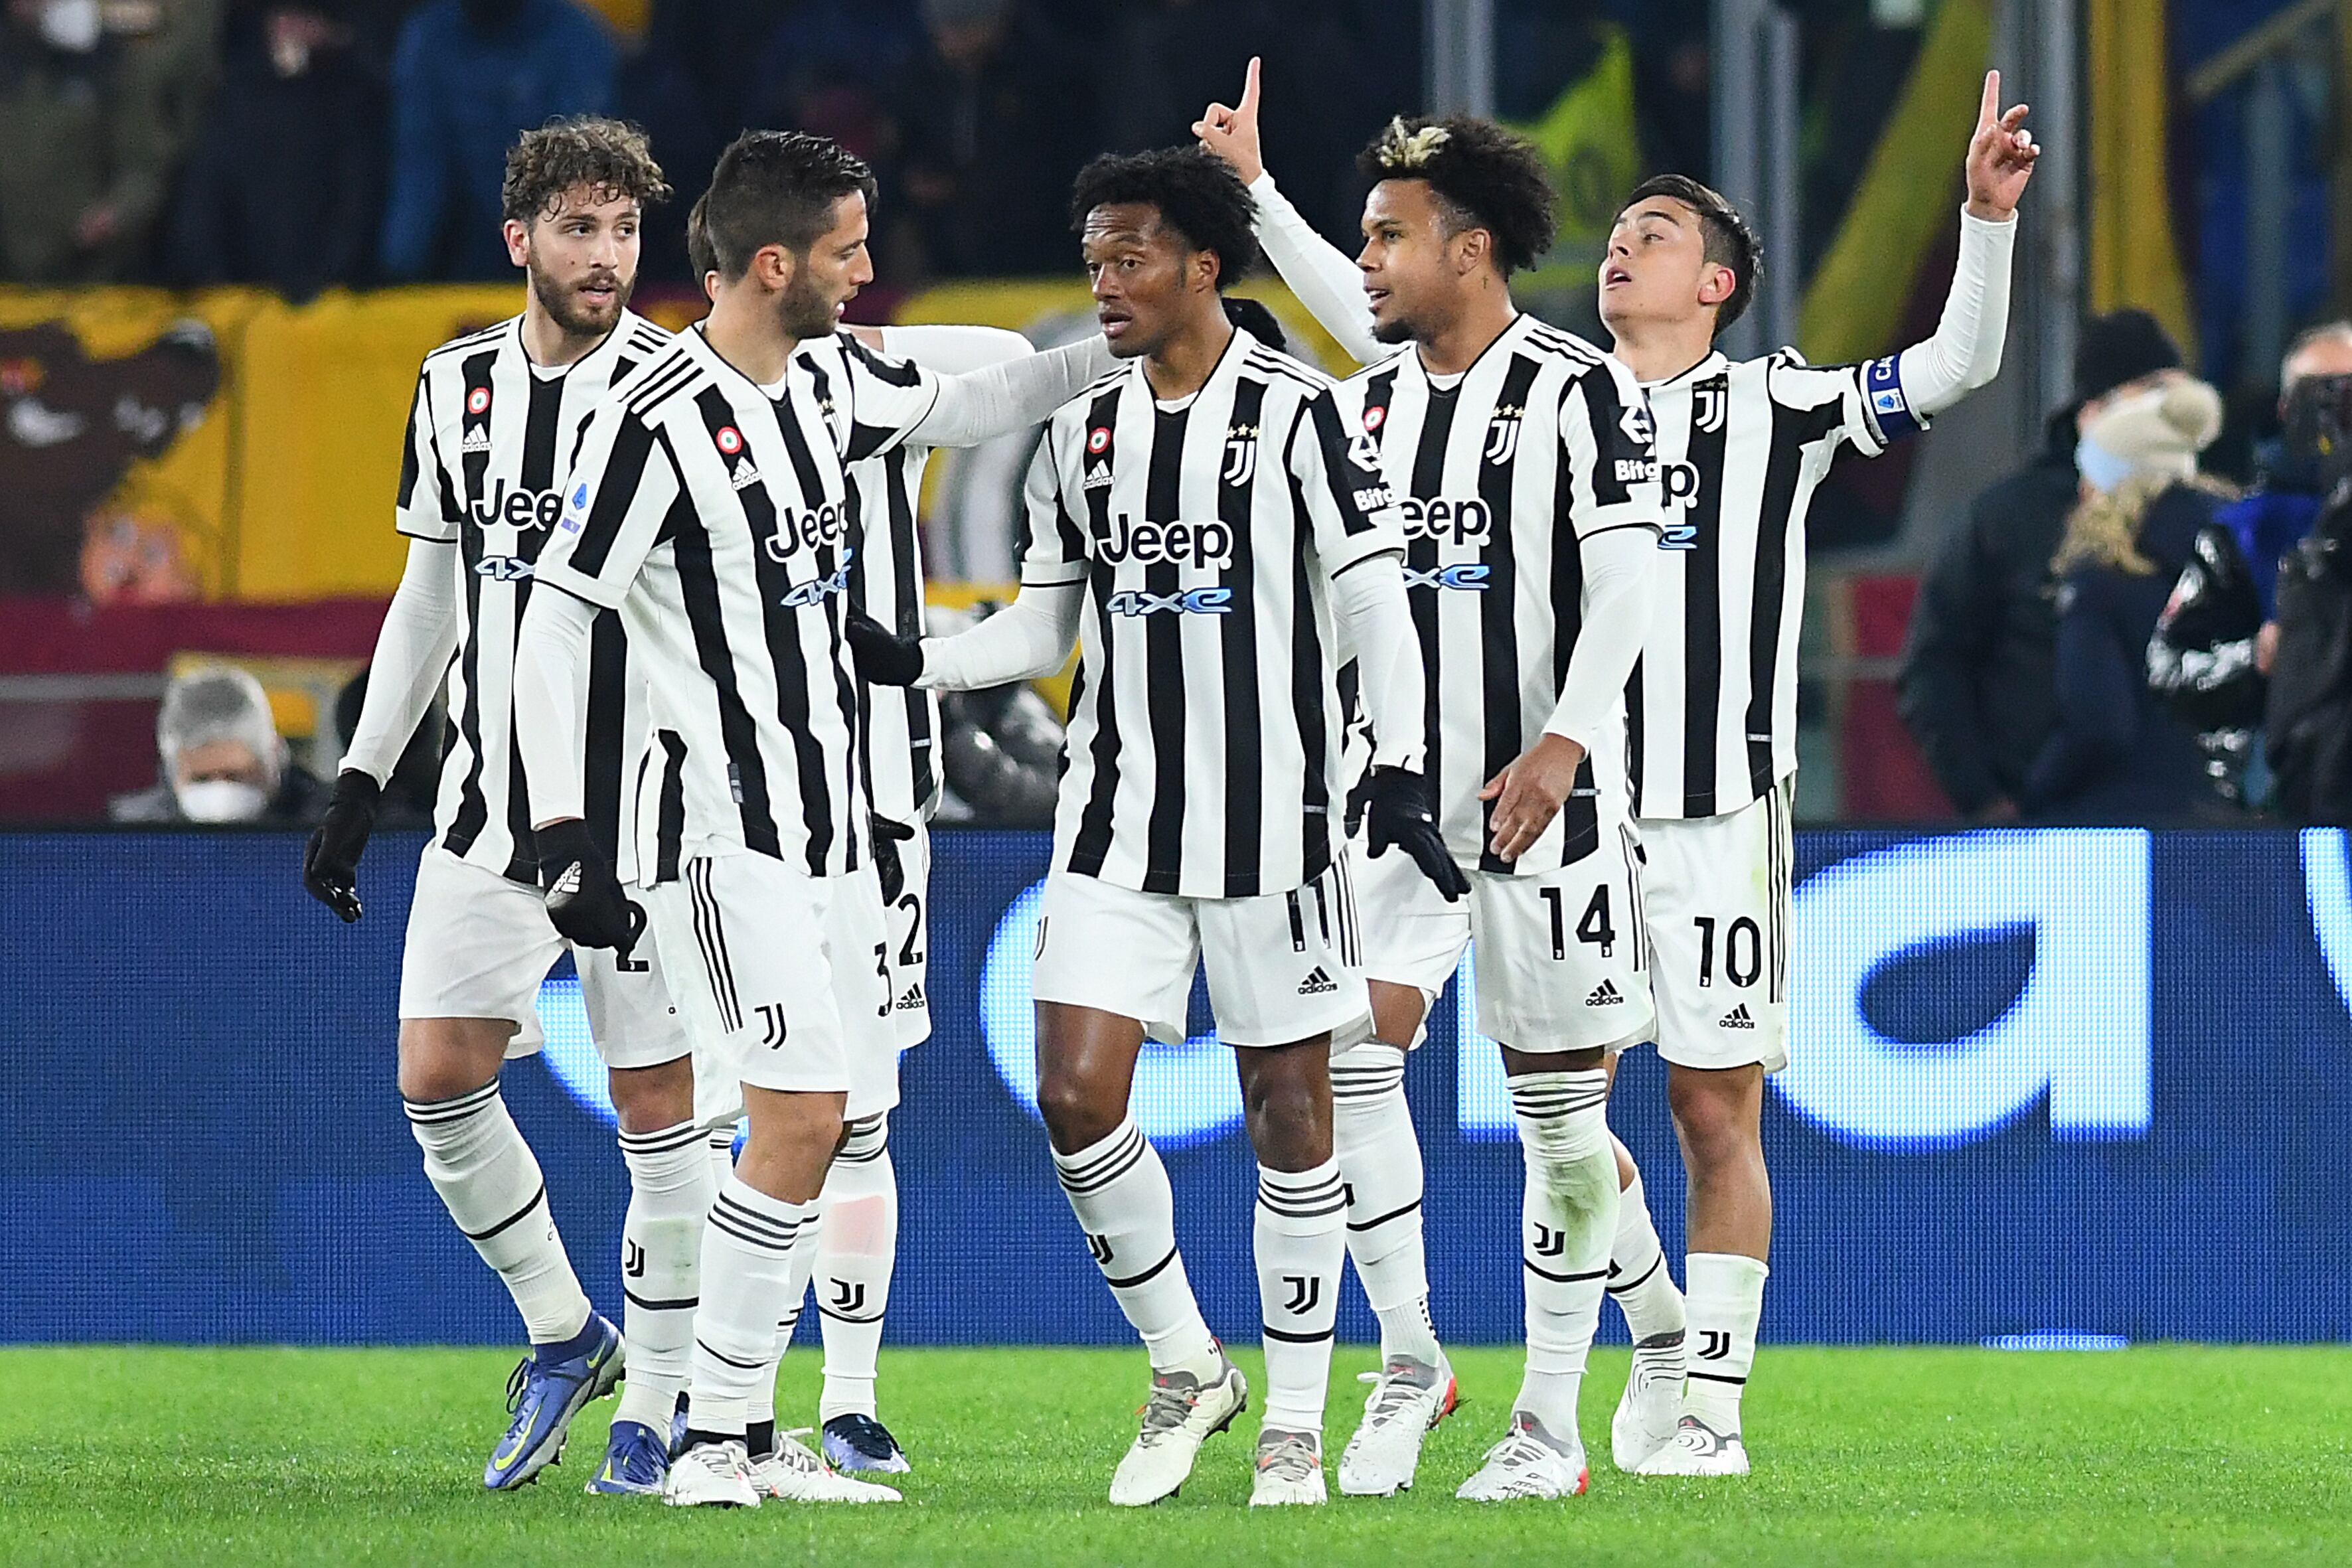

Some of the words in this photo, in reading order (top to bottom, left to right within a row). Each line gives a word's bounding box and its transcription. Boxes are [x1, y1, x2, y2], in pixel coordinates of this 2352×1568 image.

[1101, 513, 1231, 570] Jeep
[1401, 501, 1487, 546] eep
[898, 893, 923, 967] 2
[1285, 876, 1332, 953] 11
[1539, 884, 1616, 961] 14
[1693, 915, 1763, 988] 10
[1297, 980, 1338, 995] adidas
[1585, 995, 1624, 1006] adidas
[1719, 1018, 1755, 1030] adidas
